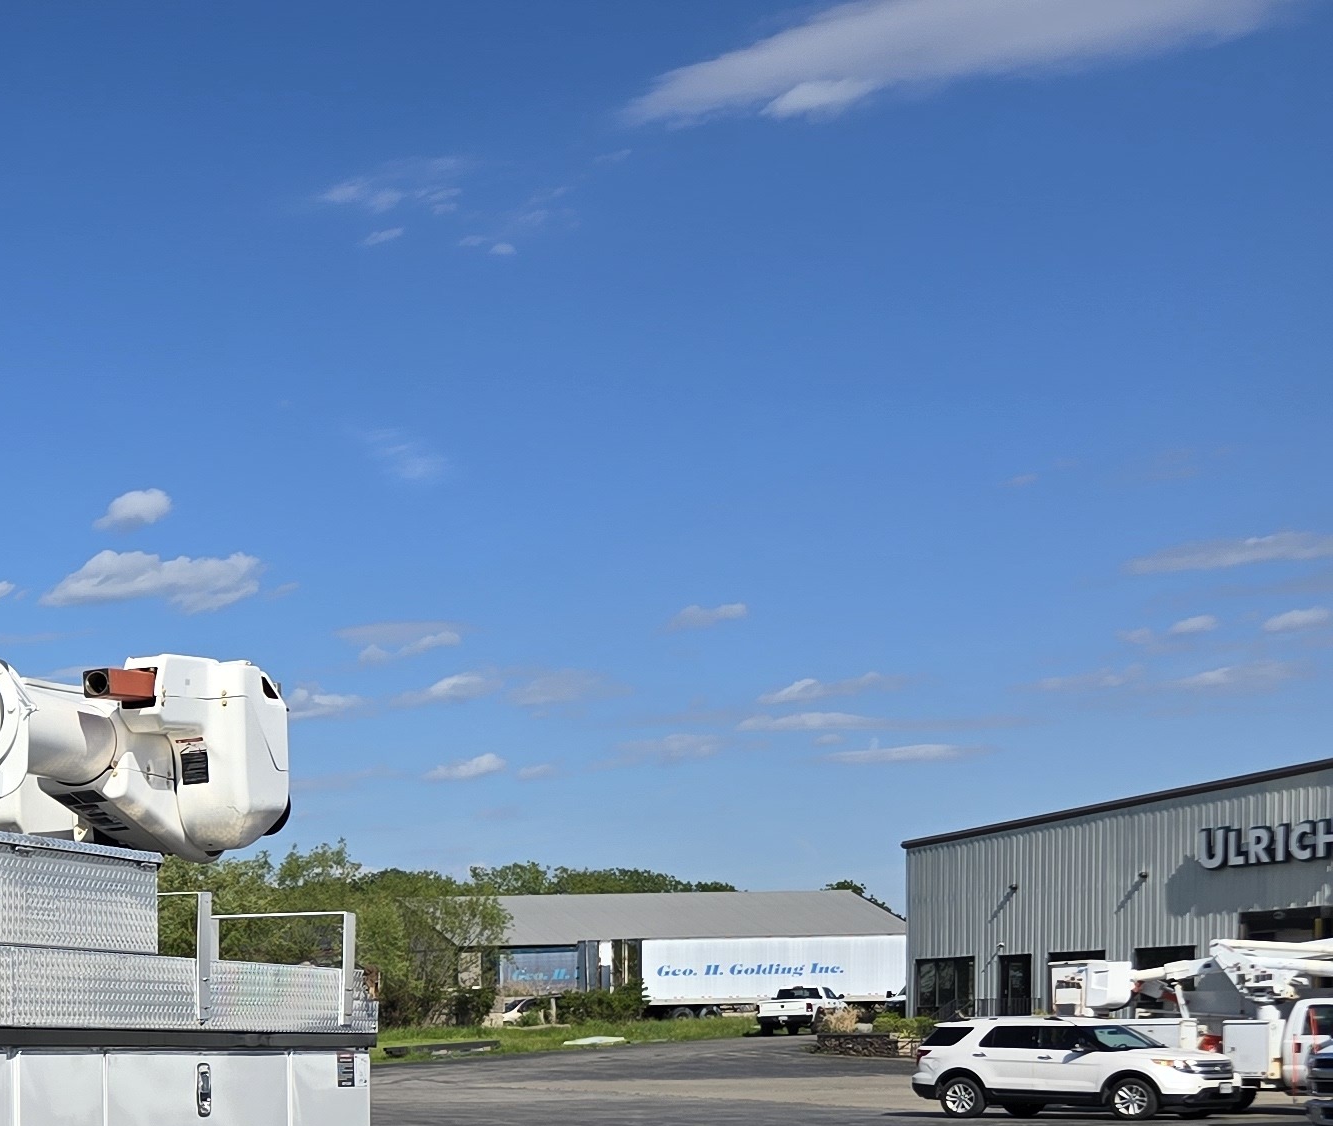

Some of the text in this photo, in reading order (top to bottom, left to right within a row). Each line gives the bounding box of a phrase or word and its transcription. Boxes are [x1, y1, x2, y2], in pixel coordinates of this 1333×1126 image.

[1198, 819, 1333, 869] ULRICH
[656, 964, 698, 977] Geo.
[729, 963, 806, 977] Golding
[810, 962, 845, 974] Inc.
